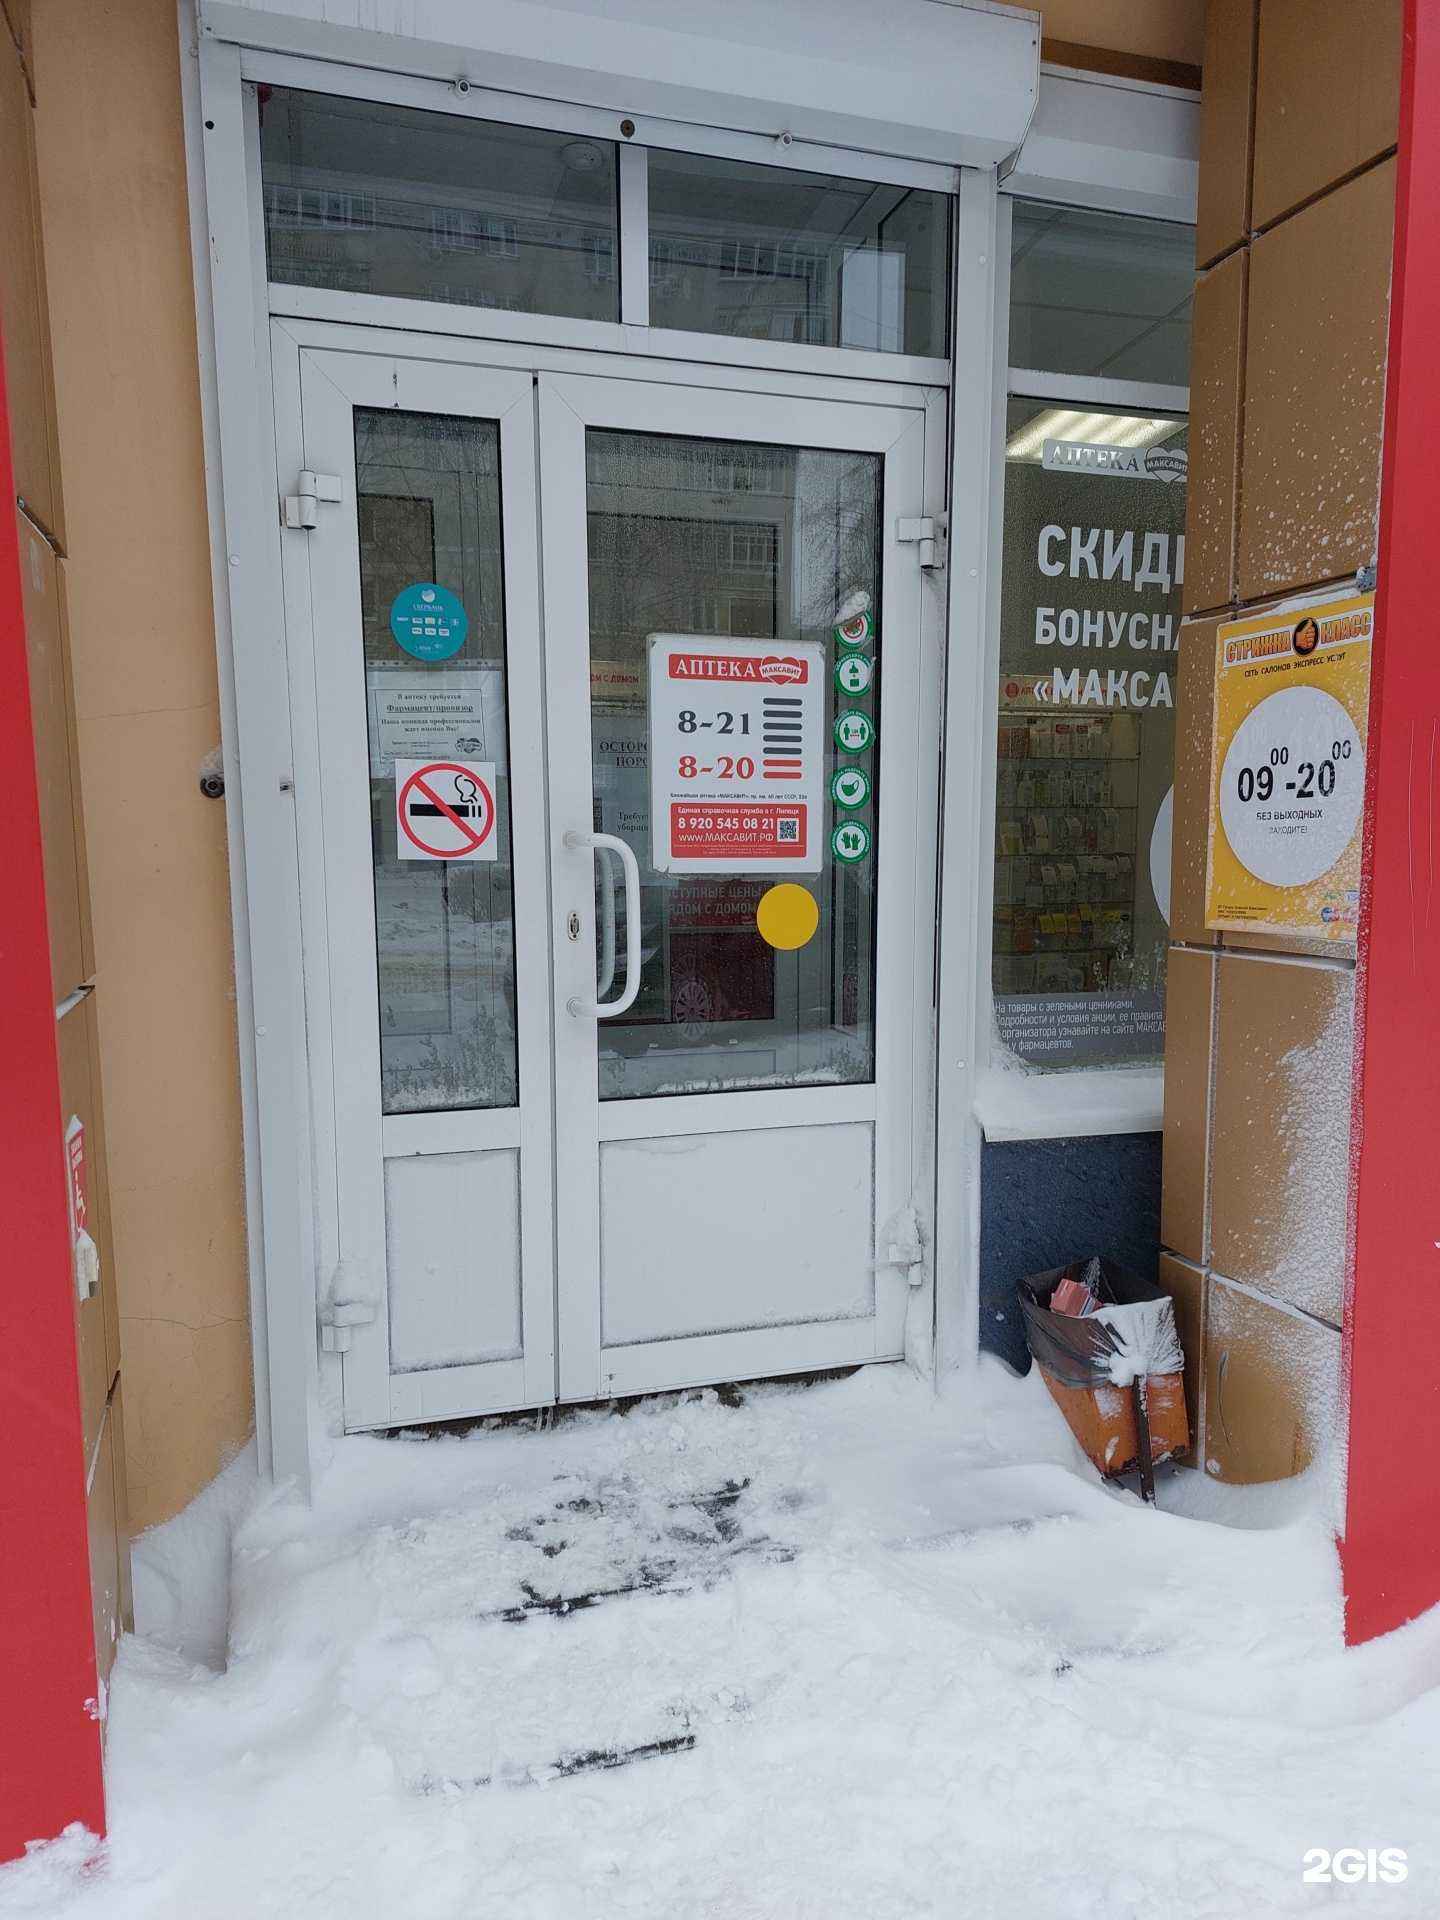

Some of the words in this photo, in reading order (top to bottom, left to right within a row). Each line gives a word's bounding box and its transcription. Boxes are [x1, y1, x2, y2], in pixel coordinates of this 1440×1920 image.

[1050, 445, 1140, 472] АПТЕКА
[1320, 611, 1371, 645] КЛАСС
[675, 658, 756, 678] АПТЕКА
[761, 664, 800, 678] МАКСАВИТ
[1244, 669, 1259, 678] СЕТЬ
[1261, 662, 1291, 675] САЛОНОВ
[678, 711, 750, 735] 8-21
[678, 756, 755, 780] 8-20
[678, 817, 686, 829] 8
[689, 818, 713, 829] 920
[716, 818, 739, 829] 545
[742, 818, 758, 829] 08
[762, 818, 774, 829] 21
[1273, 809, 1323, 820] ВЫХОДНЫХ
[1008, 1001, 1037, 1014] товары
[1056, 1013, 1090, 1026] условия
[1001, 1026, 1057, 1040] организатора
[1058, 1024, 1100, 1038] узнавайте
[1100, 1025, 1111, 1034] на
[1112, 1022, 1135, 1034] сайте
